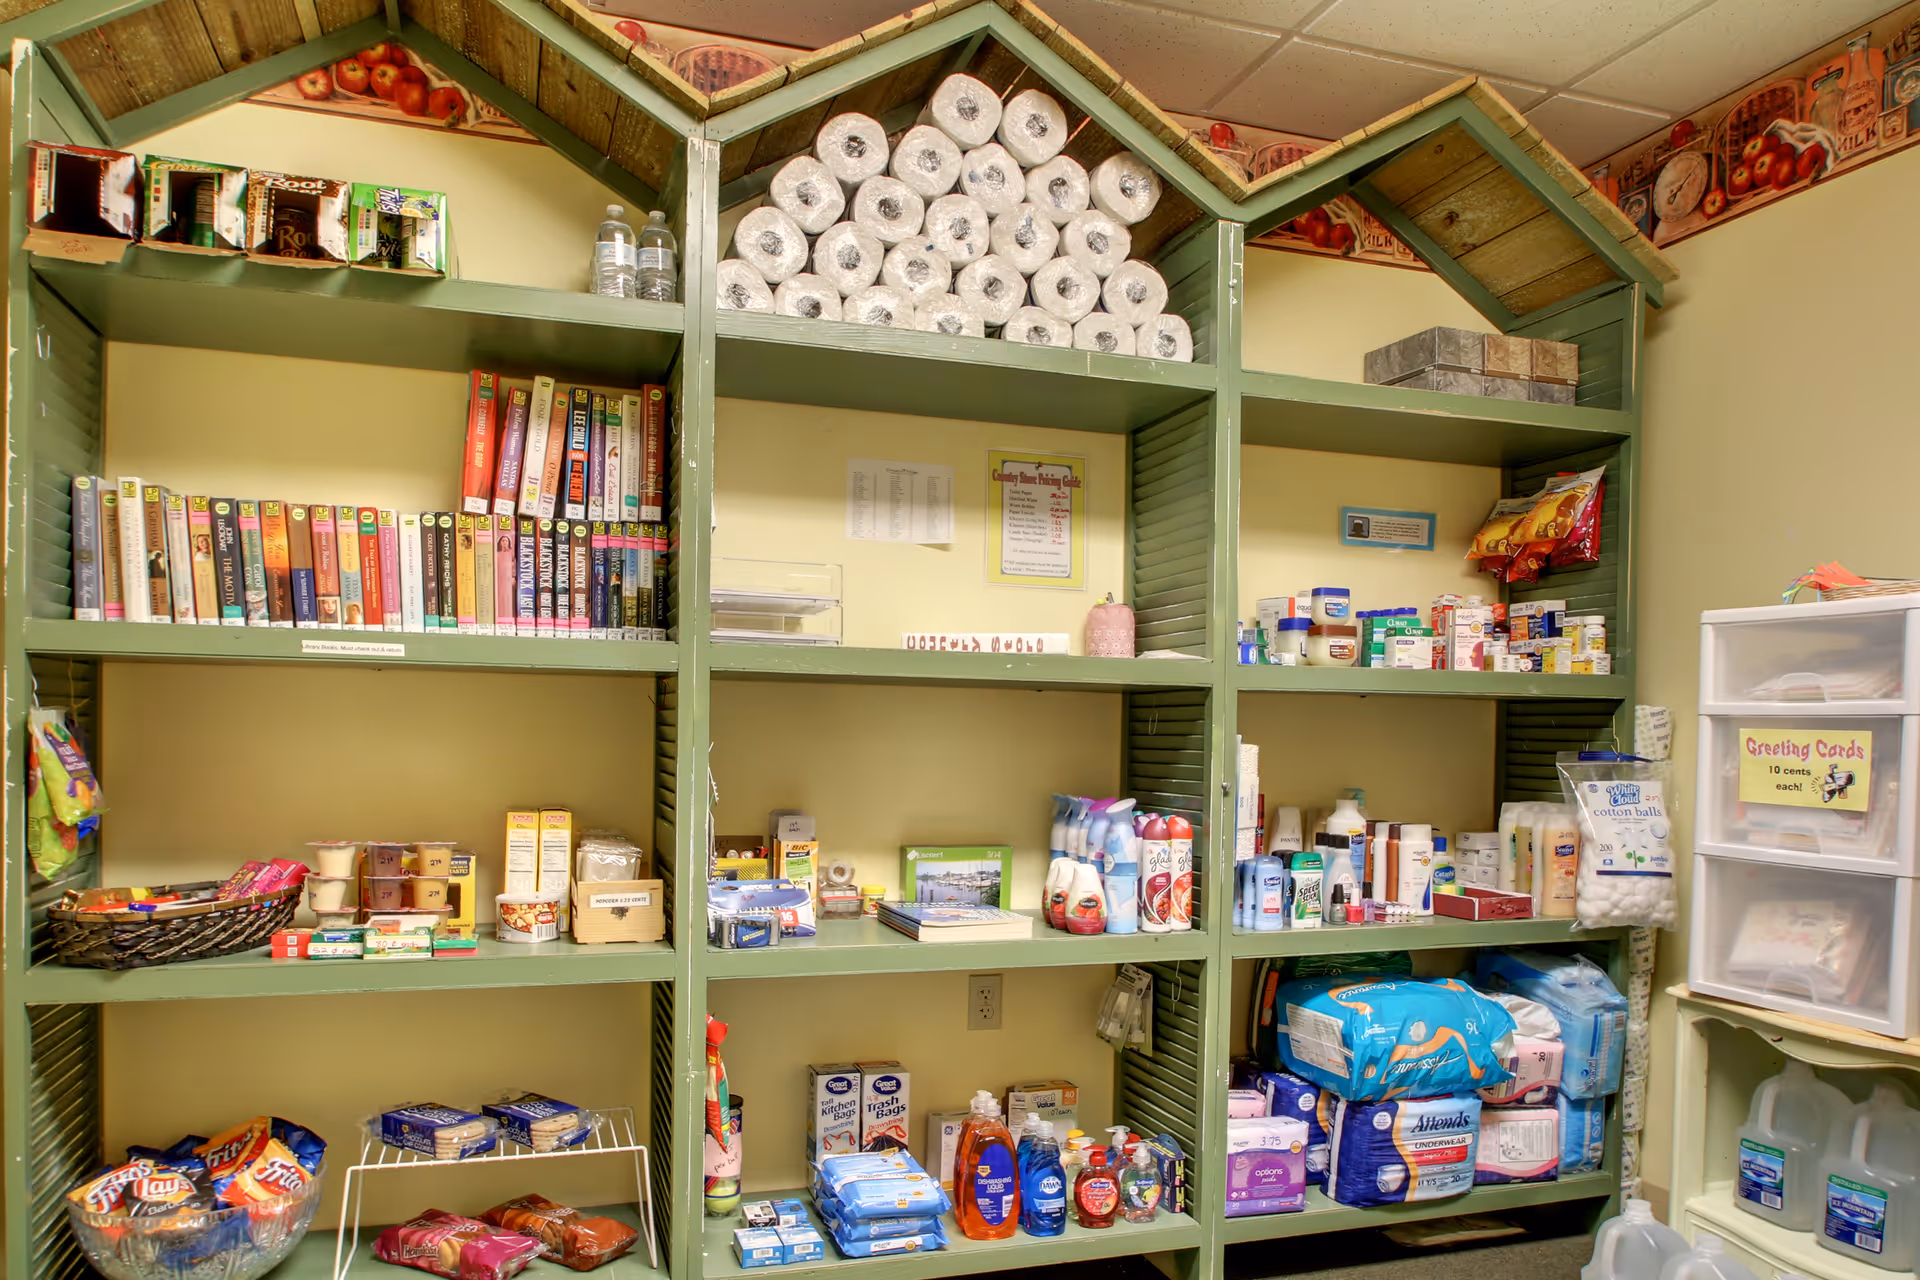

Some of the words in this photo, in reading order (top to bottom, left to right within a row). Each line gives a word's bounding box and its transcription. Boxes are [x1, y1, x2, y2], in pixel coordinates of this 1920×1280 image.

[260, 176, 328, 191] Root
[513, 408, 523, 429] Fallen
[573, 410, 586, 425] LEE
[509, 431, 519, 456] Women
[572, 426, 585, 450] CHILD
[500, 460, 510, 488] DALLAS
[508, 460, 518, 489] SANDRA
[573, 462, 582, 472] THE
[570, 472, 584, 502] ENEMY
[992, 469, 1019, 487] Country
[1019, 471, 1038, 486] Store
[1038, 473, 1062, 490] Pricing
[148, 510, 159, 548] GRISHAM
[226, 527, 234, 544] JOHN
[223, 556, 233, 573] THE
[520, 536, 534, 590] BLACKSTOCK
[540, 537, 552, 589] BLACKSTOCK
[557, 543, 569, 589] BLACKSTOCK
[574, 546, 586, 589] BLACKSTOCK
[244, 566, 253, 586] COX
[253, 563, 266, 588] Carol
[224, 575, 235, 607] MOTIV
[300, 577, 308, 596] SUMMER
[520, 594, 533, 609] LAST
[1746, 736, 1811, 762] Greeting
[1816, 739, 1865, 760] Cards
[1768, 765, 1781, 775] 10
[1783, 767, 1812, 777] cents
[1606, 783, 1641, 798] White
[1775, 782, 1803, 792] each!
[1609, 793, 1641, 807] Cloud
[1593, 807, 1632, 818] cotton
[1635, 806, 1663, 818] balls
[791, 843, 809, 852] BIC
[1599, 843, 1614, 852] 200
[1649, 854, 1669, 864] jumbo
[1433, 868, 1456, 879] Cetaphil
[1297, 880, 1321, 898] SPEED
[1302, 892, 1318, 903] STICK
[780, 911, 794, 922] 16
[1338, 981, 1402, 1001] Assurance
[1538, 1051, 1547, 1063] 20
[827, 1079, 850, 1089] Great
[874, 1078, 898, 1089] Great
[880, 1085, 899, 1093] Value
[820, 1097, 834, 1107] Tall
[1031, 1092, 1057, 1104] Great
[1064, 1089, 1076, 1100] 40
[821, 1098, 857, 1117] Kitchen
[866, 1095, 899, 1114] Trash
[875, 1103, 907, 1120] Bags
[1036, 1100, 1057, 1109] Value
[833, 1107, 857, 1122] Bags
[823, 1119, 855, 1134] Drawstring
[867, 1115, 905, 1132] Drawstring
[1411, 1111, 1471, 1134] Attends
[1415, 1137, 1467, 1150] UNDERWEAR
[1255, 1167, 1284, 1179] options
[1750, 1163, 1777, 1178] MOUNTAIN
[977, 1176, 1013, 1186] DISHWASHING
[986, 1183, 1005, 1191] LIQUID
[1038, 1179, 1063, 1192] DAWN
[1261, 1175, 1277, 1184] pads
[1450, 1175, 1461, 1184] 20
[1830, 1176, 1863, 1191] DISTILLED
[1831, 1198, 1842, 1208] ICE
[1841, 1200, 1876, 1219] MOUNTAIN
